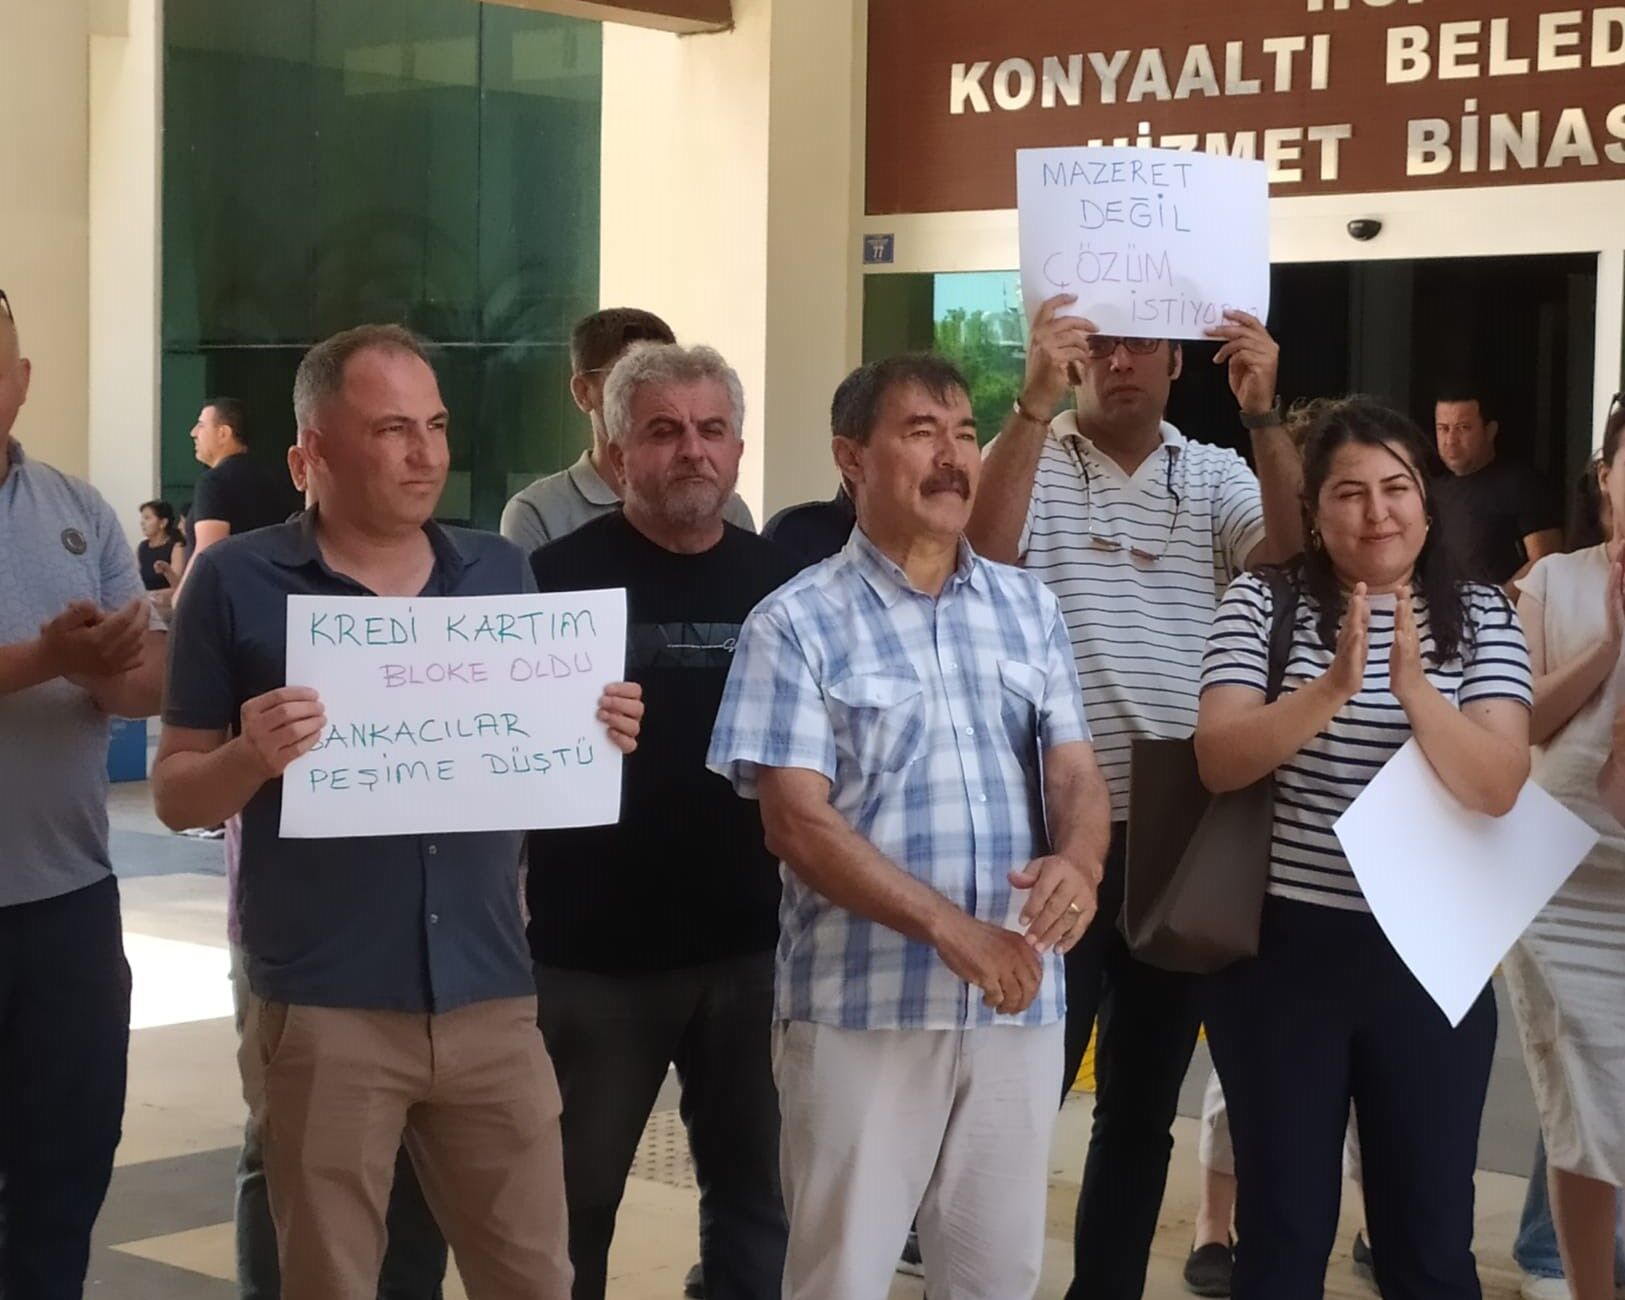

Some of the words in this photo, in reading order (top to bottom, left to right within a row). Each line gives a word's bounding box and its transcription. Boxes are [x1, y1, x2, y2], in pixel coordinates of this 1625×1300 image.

[950, 34, 1331, 114] KONYAALTI
[1386, 6, 1625, 84] BELED
[1043, 160, 1193, 188] MAZERET
[1079, 193, 1191, 233] DEĞİL
[1042, 241, 1174, 289] ÇÖZÜM
[310, 606, 417, 646] KREDİ
[446, 609, 598, 645] KARTIM
[379, 662, 489, 688] BLOKE
[509, 651, 593, 682] OLDU
[309, 712, 531, 752] ANKACILAR
[309, 753, 455, 792] PEŞİME
[481, 737, 594, 775] DÜŞTÜ
